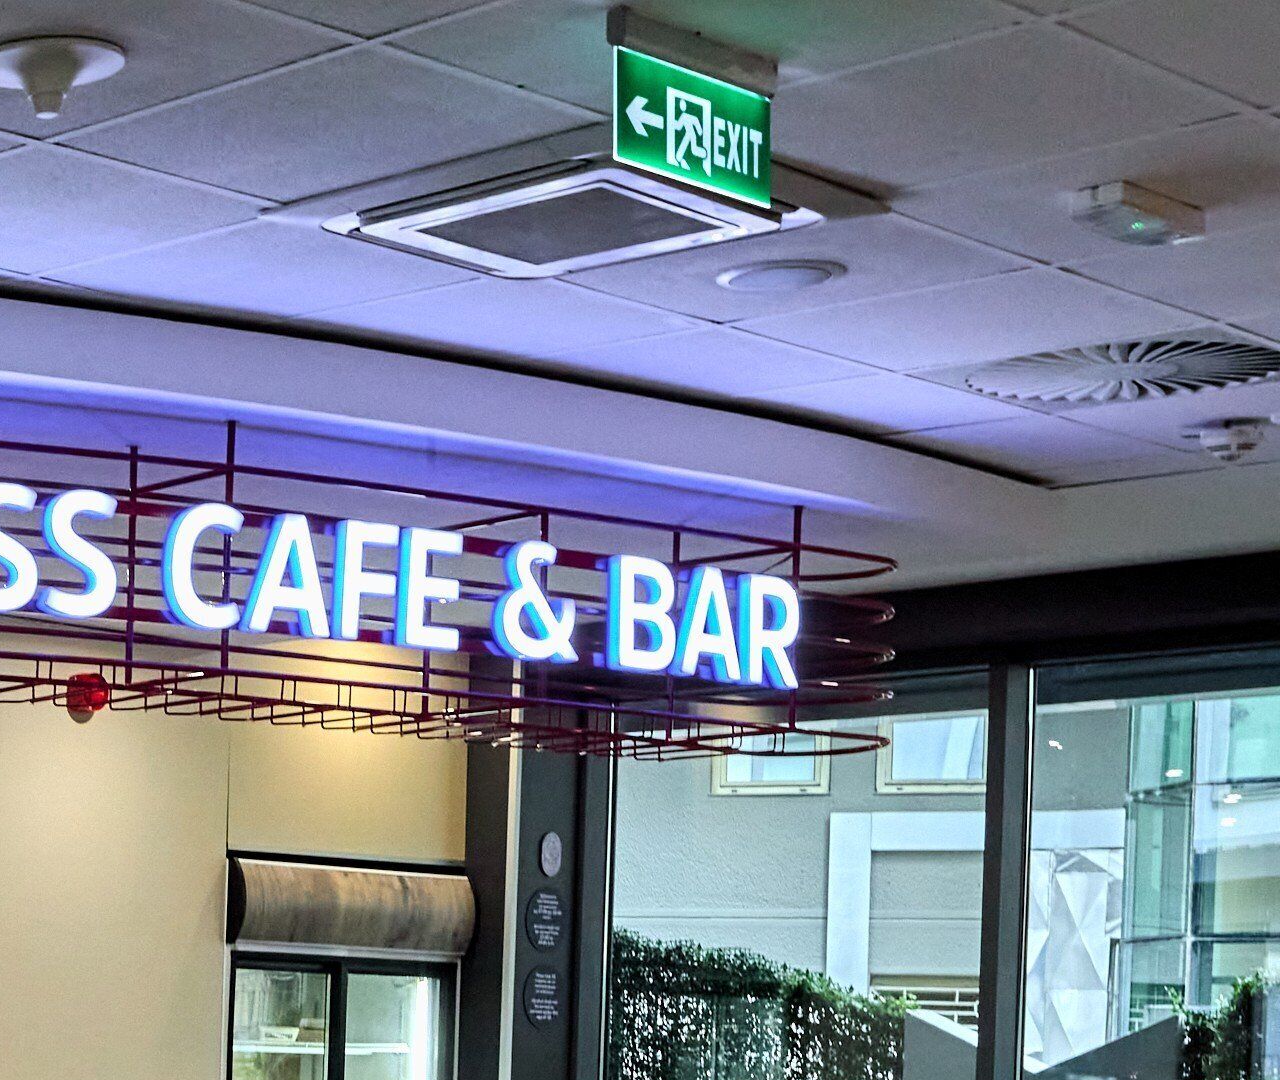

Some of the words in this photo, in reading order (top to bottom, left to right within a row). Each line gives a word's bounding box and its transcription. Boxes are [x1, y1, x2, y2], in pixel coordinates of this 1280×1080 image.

[713, 116, 763, 179] EXIT
[162, 502, 464, 653] CAFE
[490, 540, 580, 664] &
[606, 553, 801, 690] BAR
